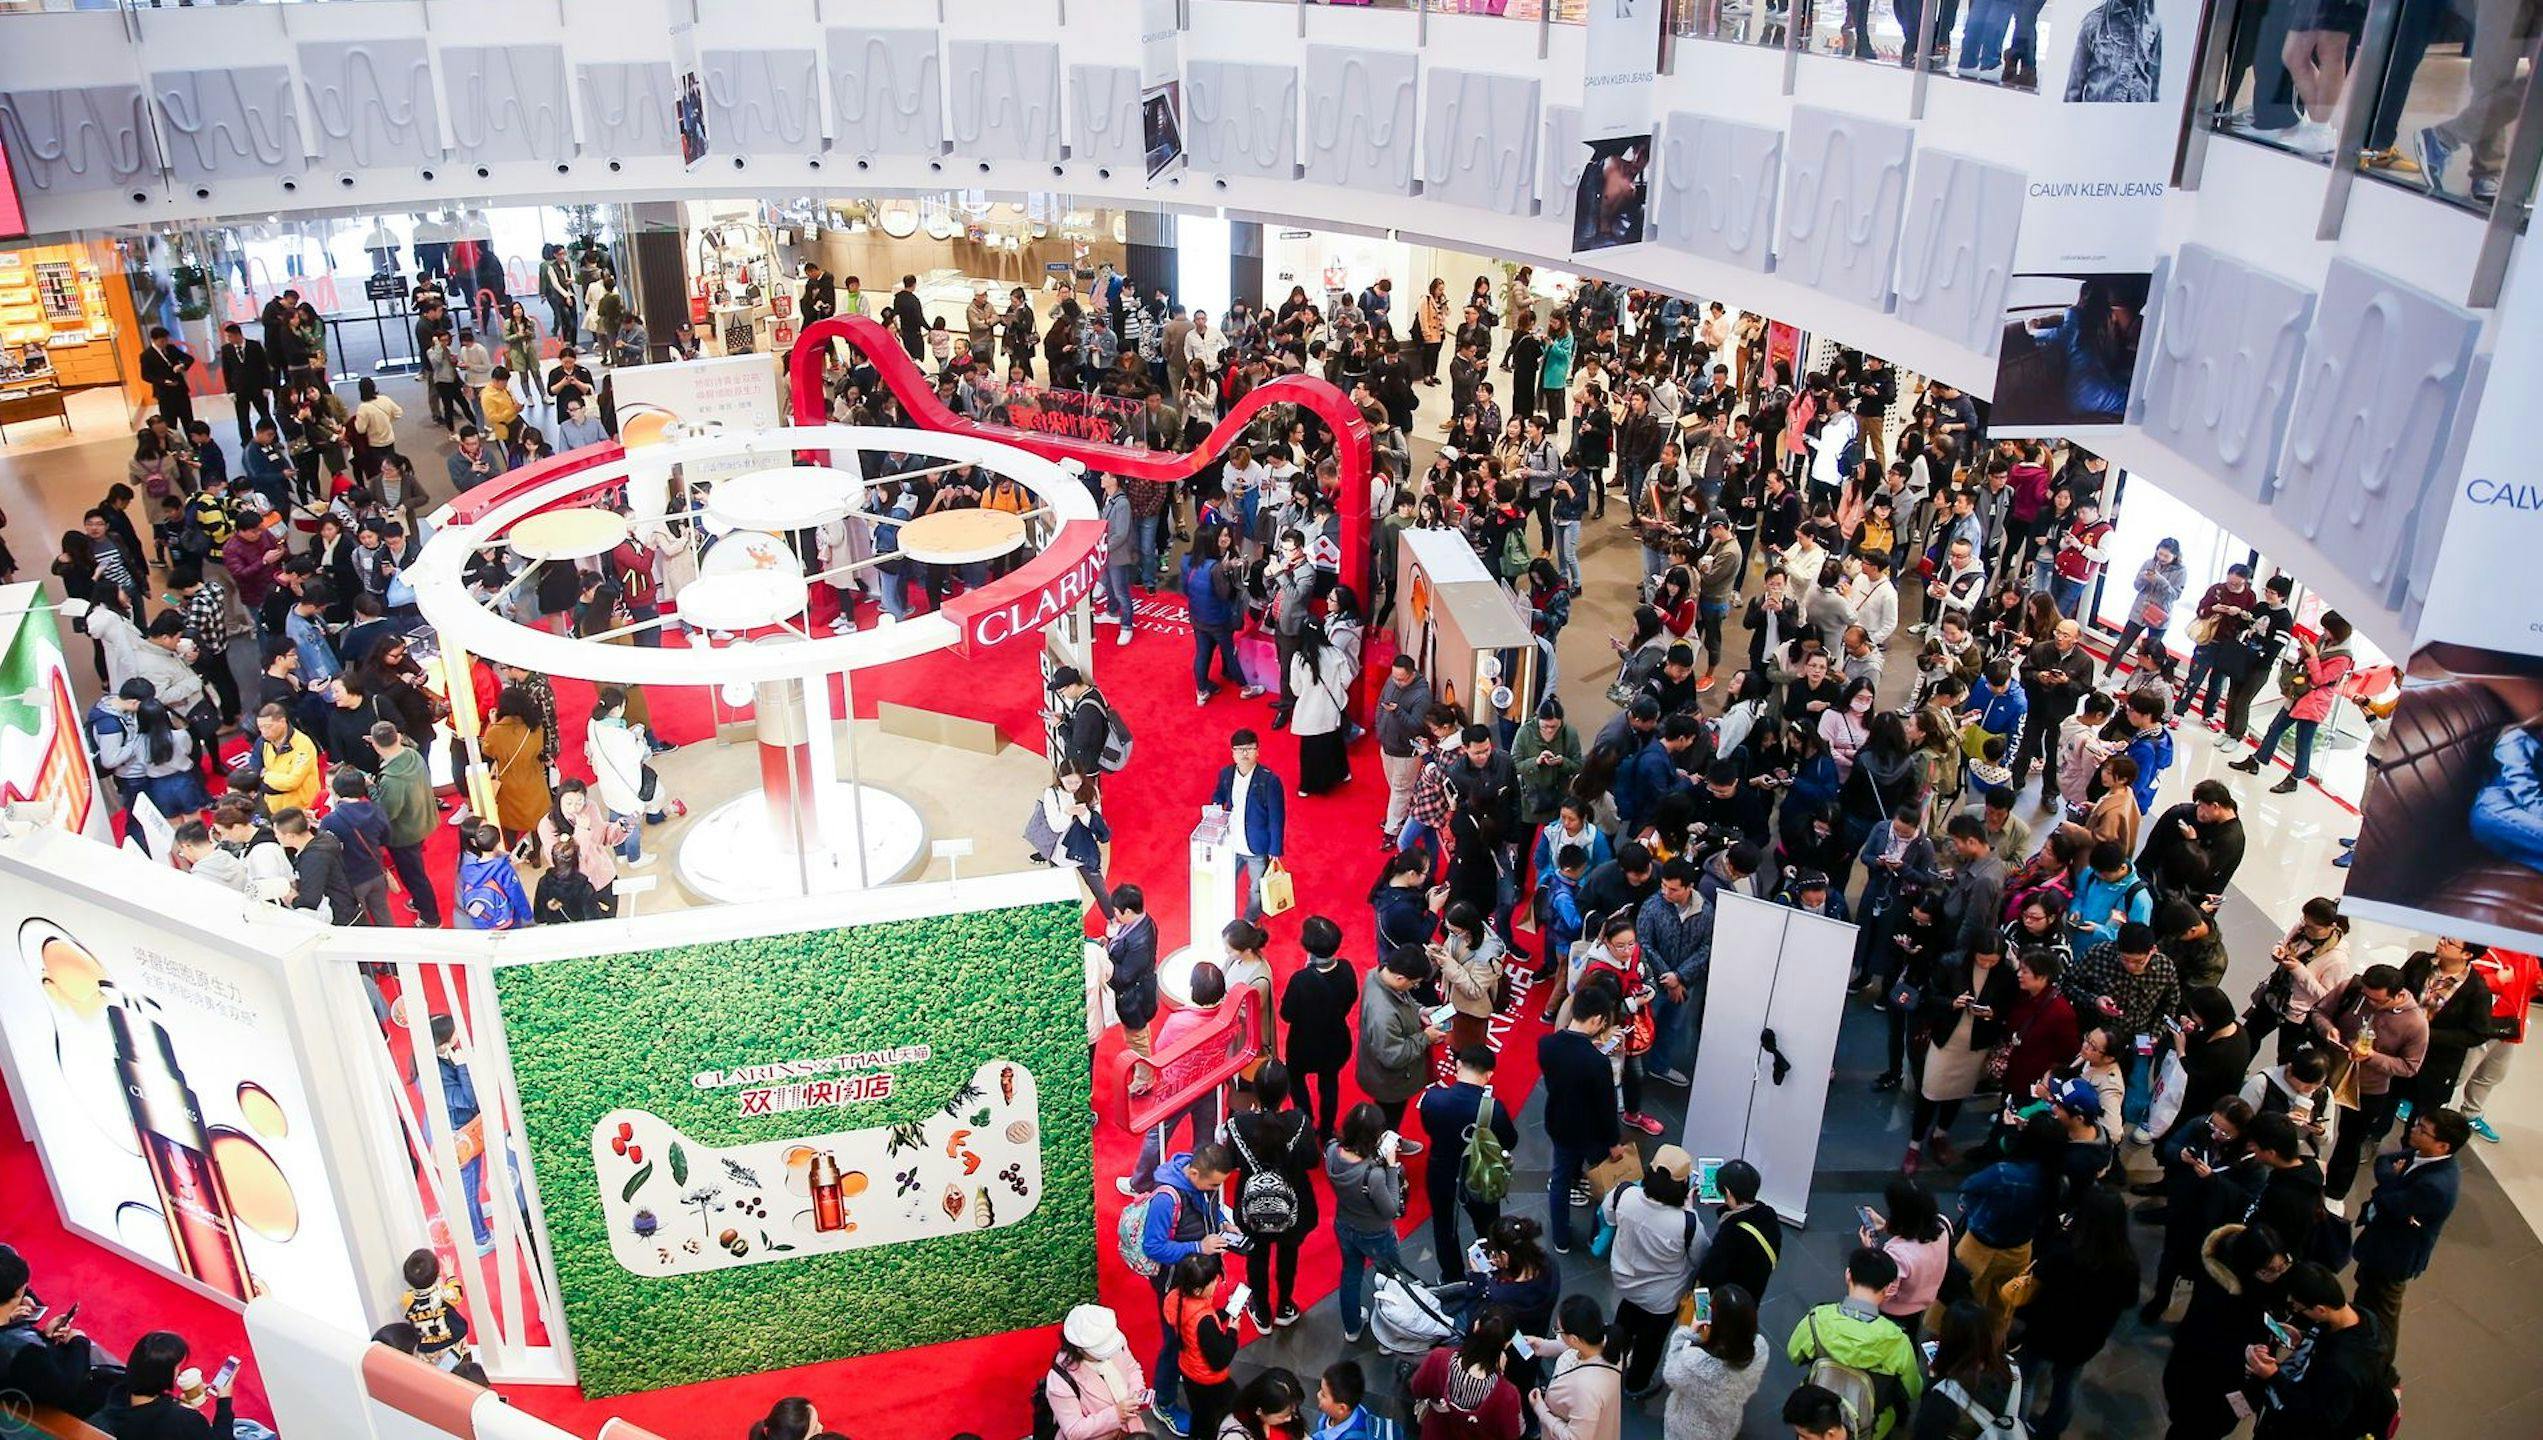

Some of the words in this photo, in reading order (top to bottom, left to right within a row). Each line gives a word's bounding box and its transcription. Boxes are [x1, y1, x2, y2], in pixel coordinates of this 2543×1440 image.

[2029, 183, 2077, 197] CALVIN
[2080, 183, 2118, 197] KLEIN
[2119, 183, 2164, 197] JEANS
[976, 532, 1109, 646] CLARINS
[694, 1065, 813, 1086] CLARINS
